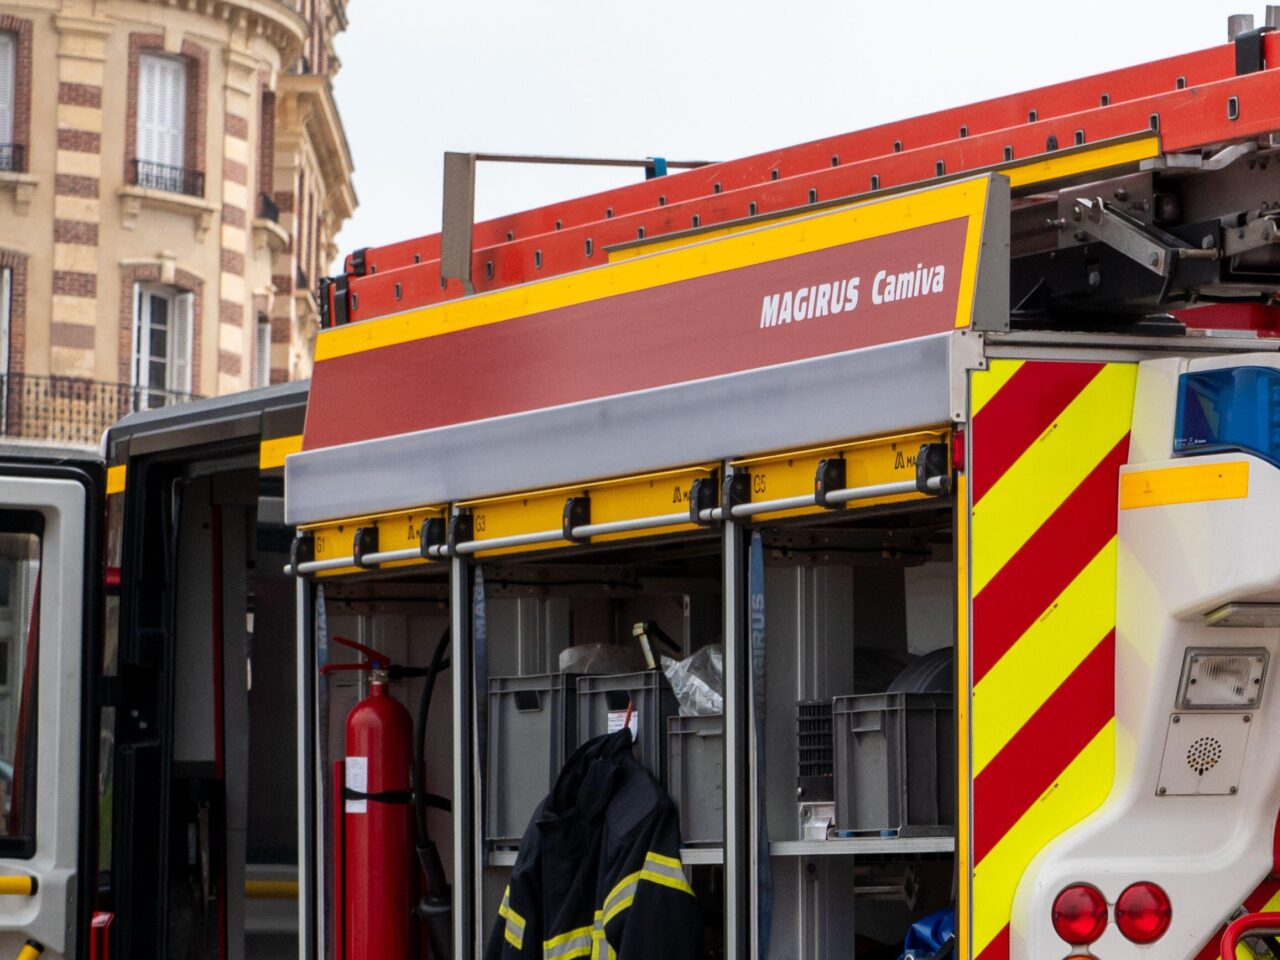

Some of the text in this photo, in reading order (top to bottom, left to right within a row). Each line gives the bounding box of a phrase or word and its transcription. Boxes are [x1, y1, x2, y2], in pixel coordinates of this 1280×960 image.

[759, 263, 946, 329] MAGIRUS Camiva
[752, 474, 766, 494] G5
[475, 514, 486, 533] G3
[316, 536, 326, 554] G1
